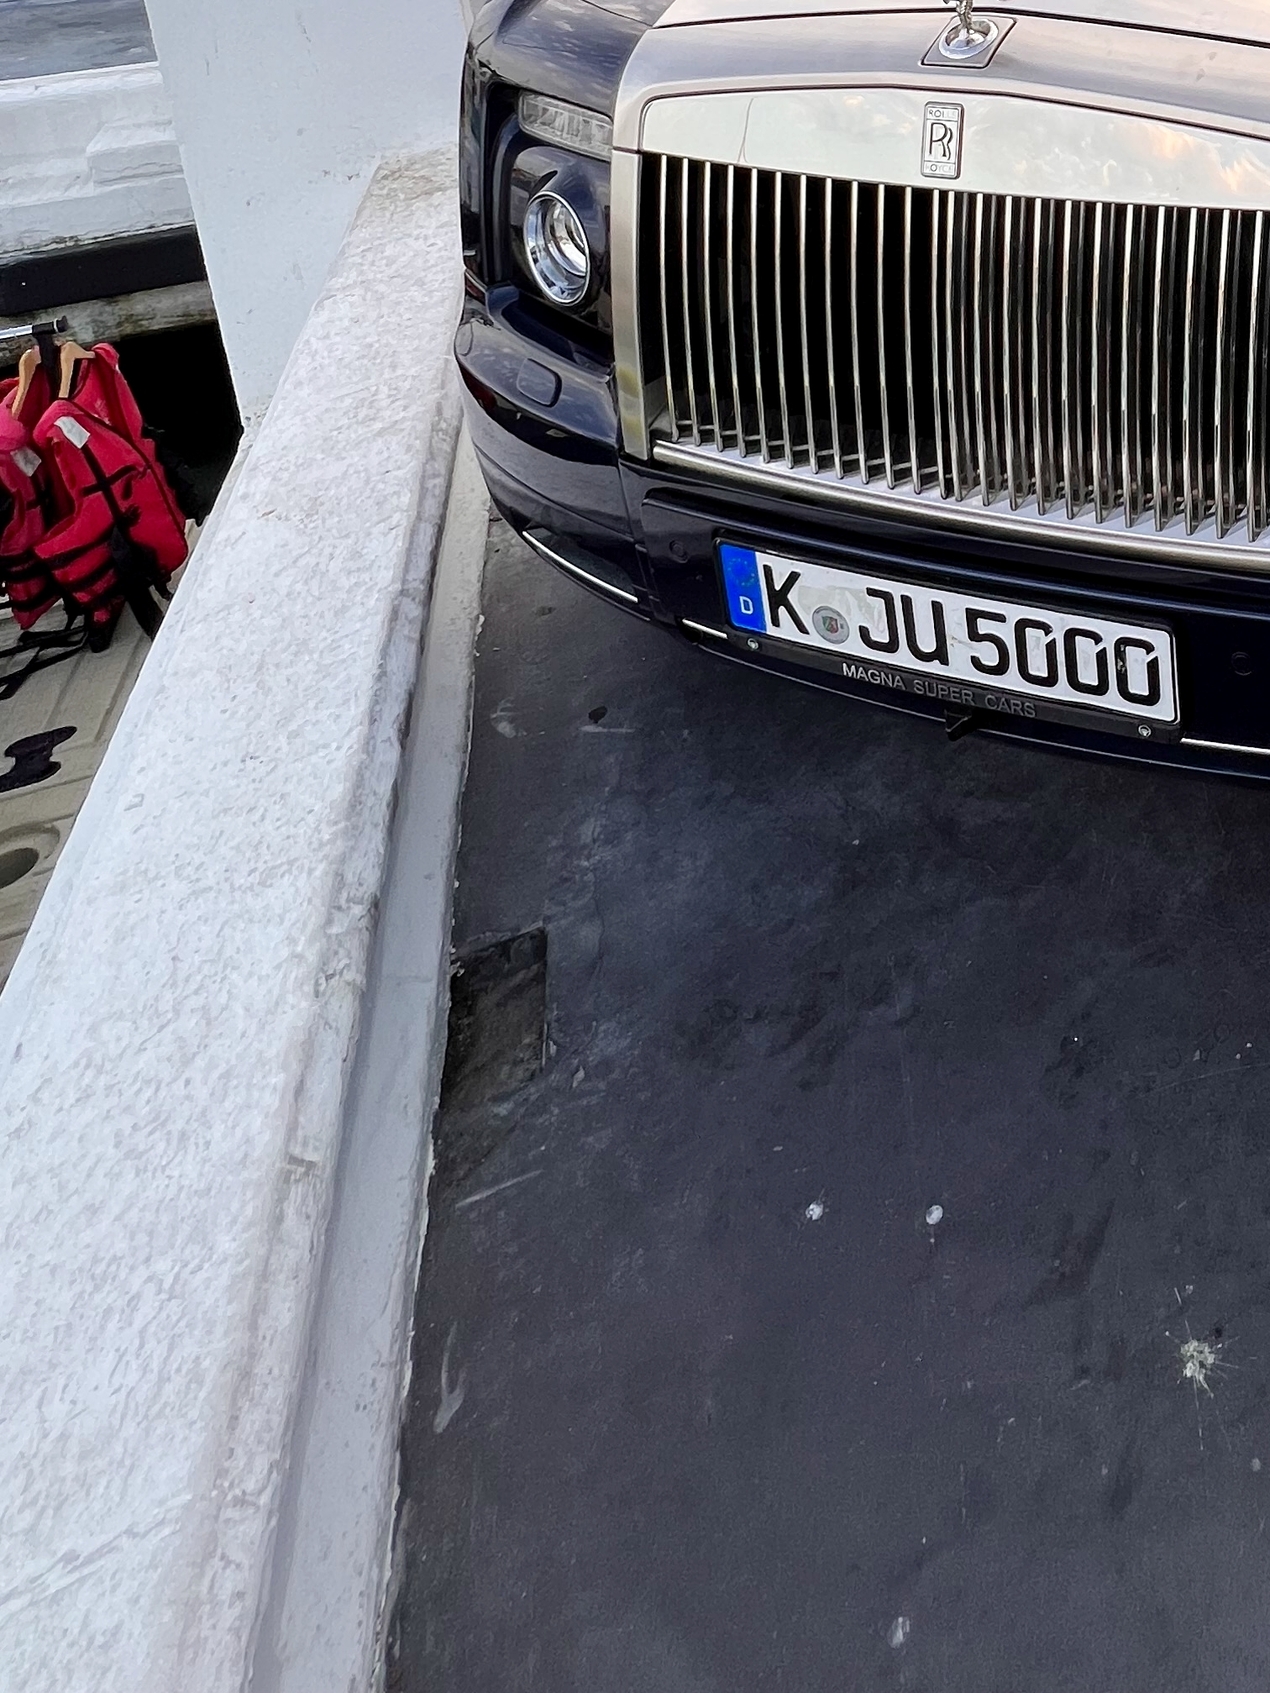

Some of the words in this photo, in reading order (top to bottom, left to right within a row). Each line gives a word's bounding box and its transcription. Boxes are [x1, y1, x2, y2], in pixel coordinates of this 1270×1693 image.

[740, 596, 754, 616] D
[762, 563, 811, 636] K
[858, 586, 949, 667] JU
[966, 610, 1159, 707] 5000
[842, 662, 907, 691] MAGNA
[913, 679, 975, 706] SUPER
[984, 694, 1037, 718] CARS
